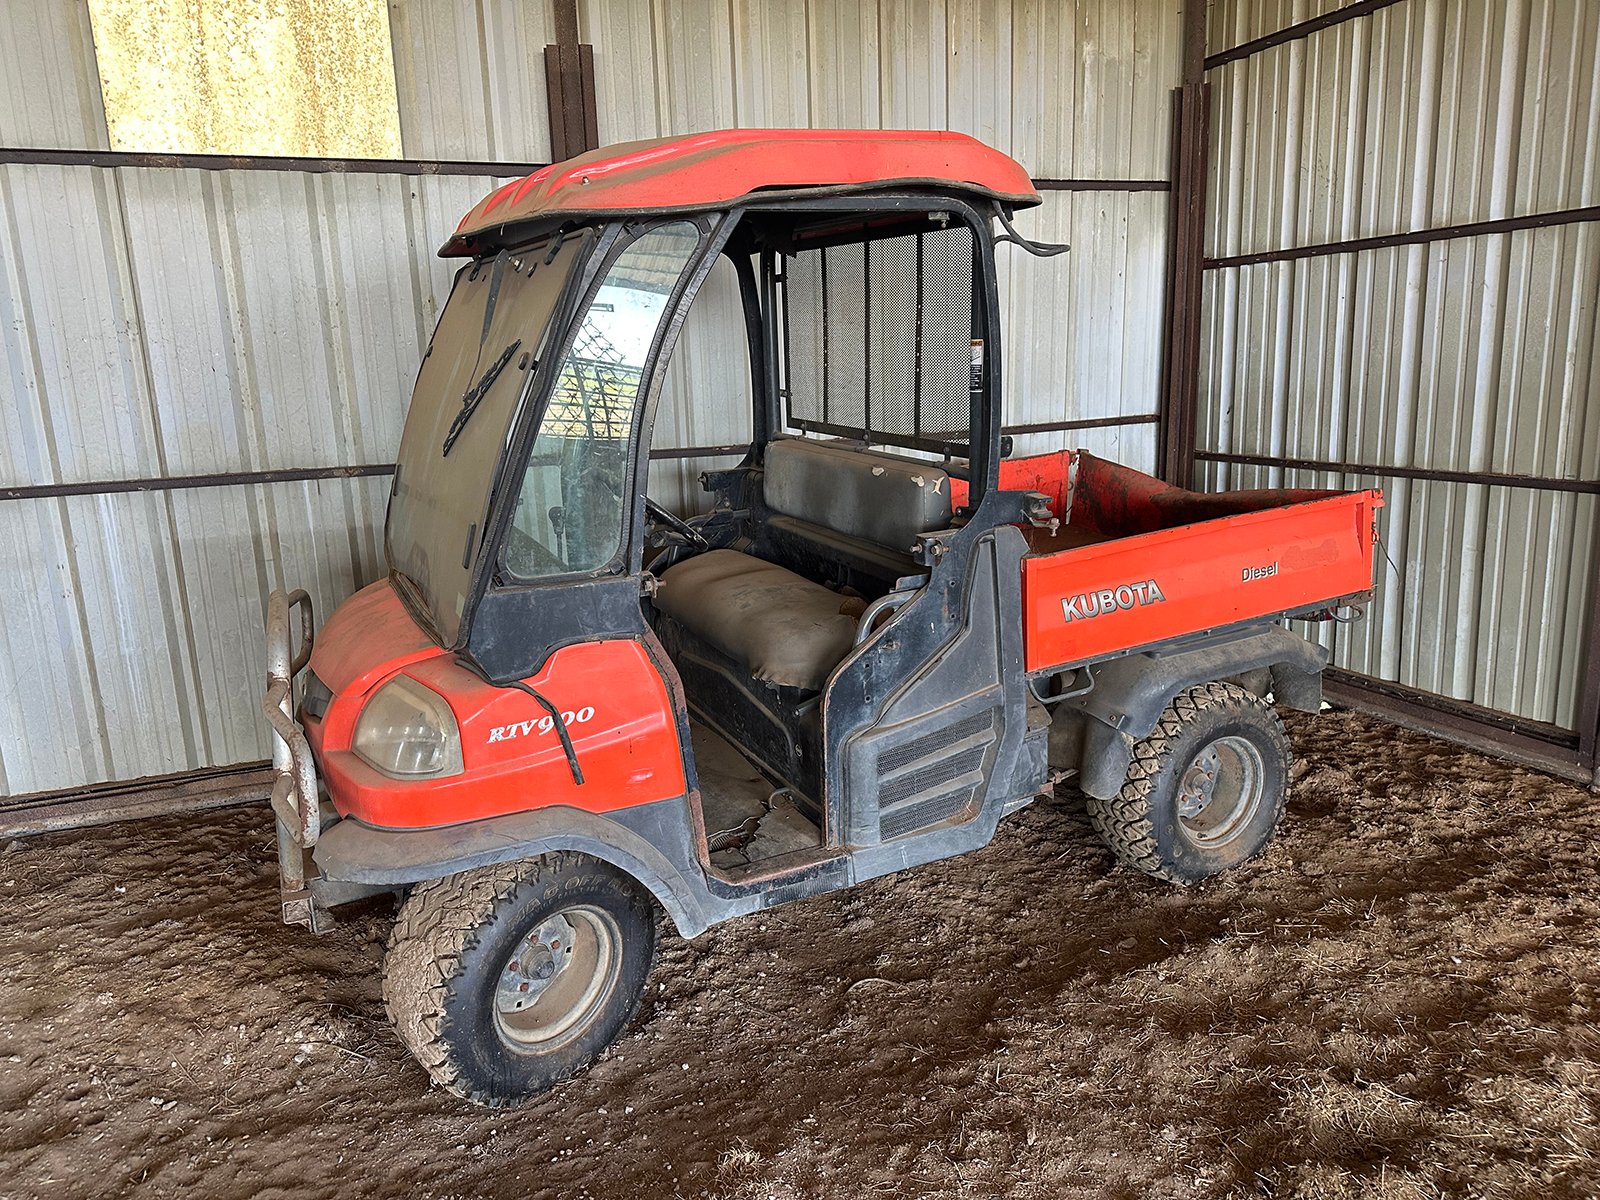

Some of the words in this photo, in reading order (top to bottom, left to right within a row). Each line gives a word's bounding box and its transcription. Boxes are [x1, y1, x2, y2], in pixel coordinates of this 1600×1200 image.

[1241, 561, 1278, 583] Diesel
[1061, 579, 1166, 622] KUBOTA
[486, 706, 595, 744] RTV900
